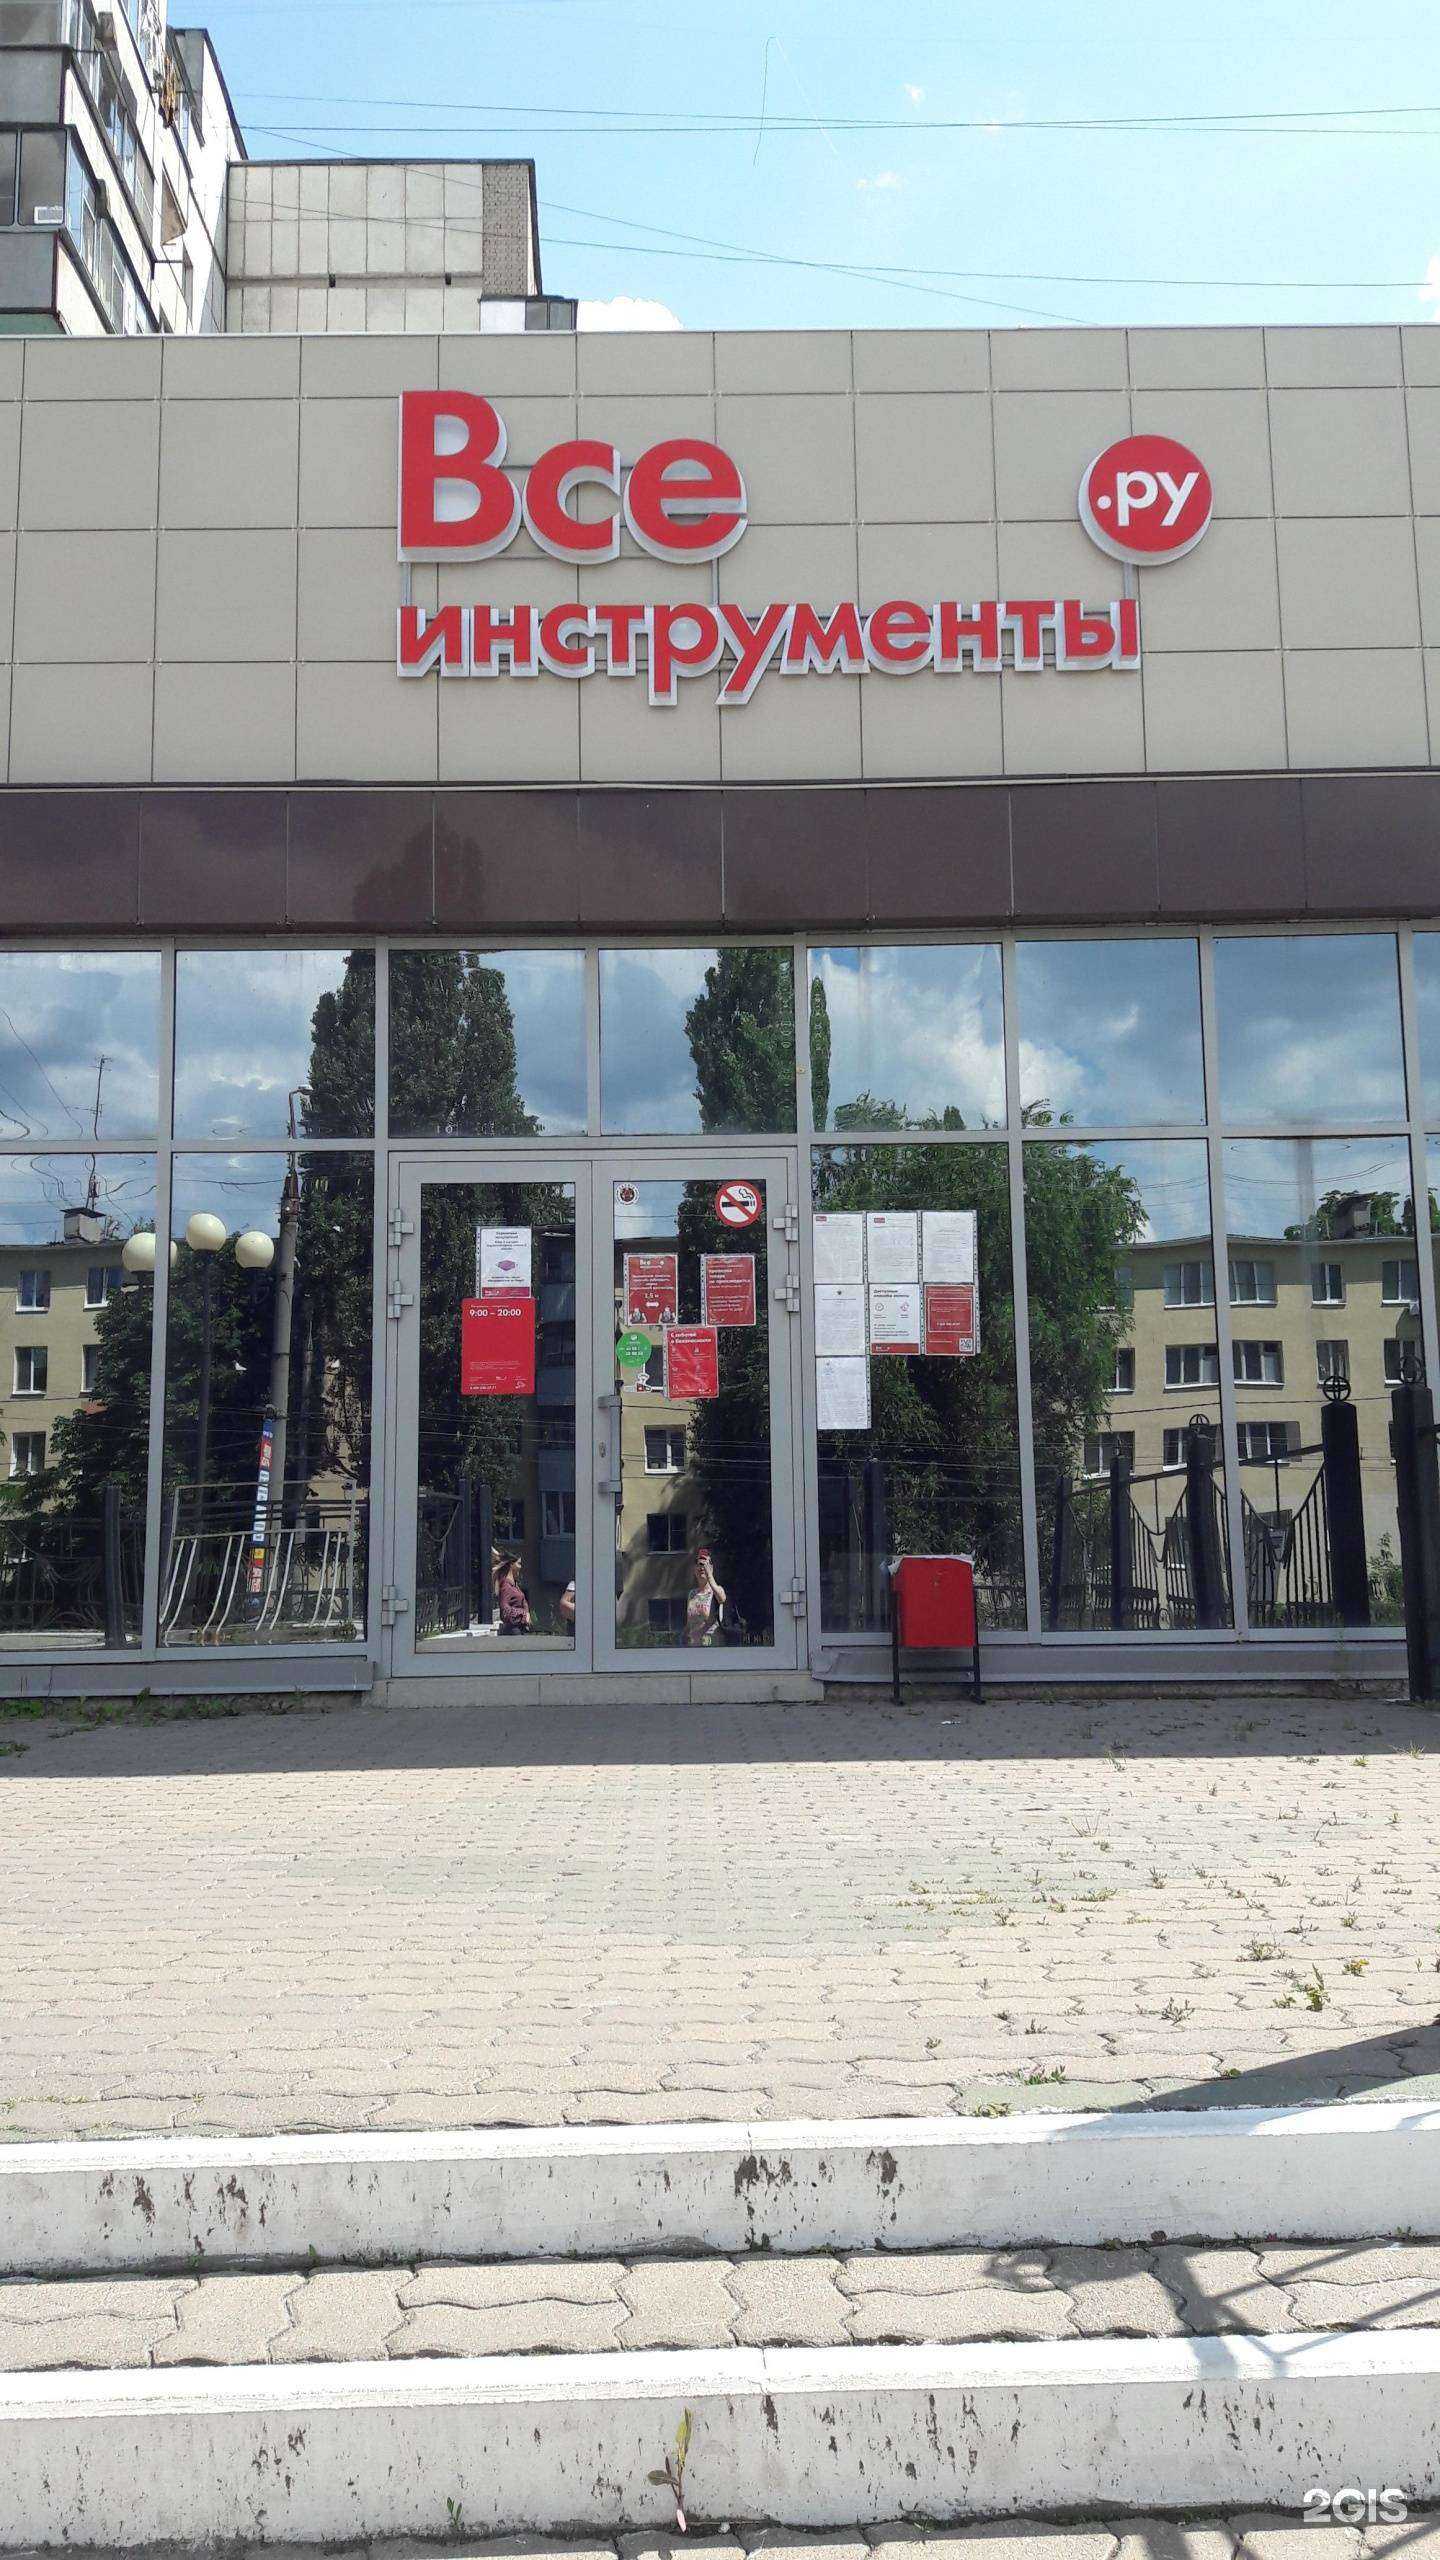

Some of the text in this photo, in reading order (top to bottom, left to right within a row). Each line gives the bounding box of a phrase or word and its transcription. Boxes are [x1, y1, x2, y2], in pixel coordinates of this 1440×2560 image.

[398, 389, 747, 564] Все
[1096, 470, 1200, 527] .ру
[397, 599, 1141, 706] инструменты
[469, 1309, 488, 1317] 9:00
[497, 1308, 521, 1317] 20:00
